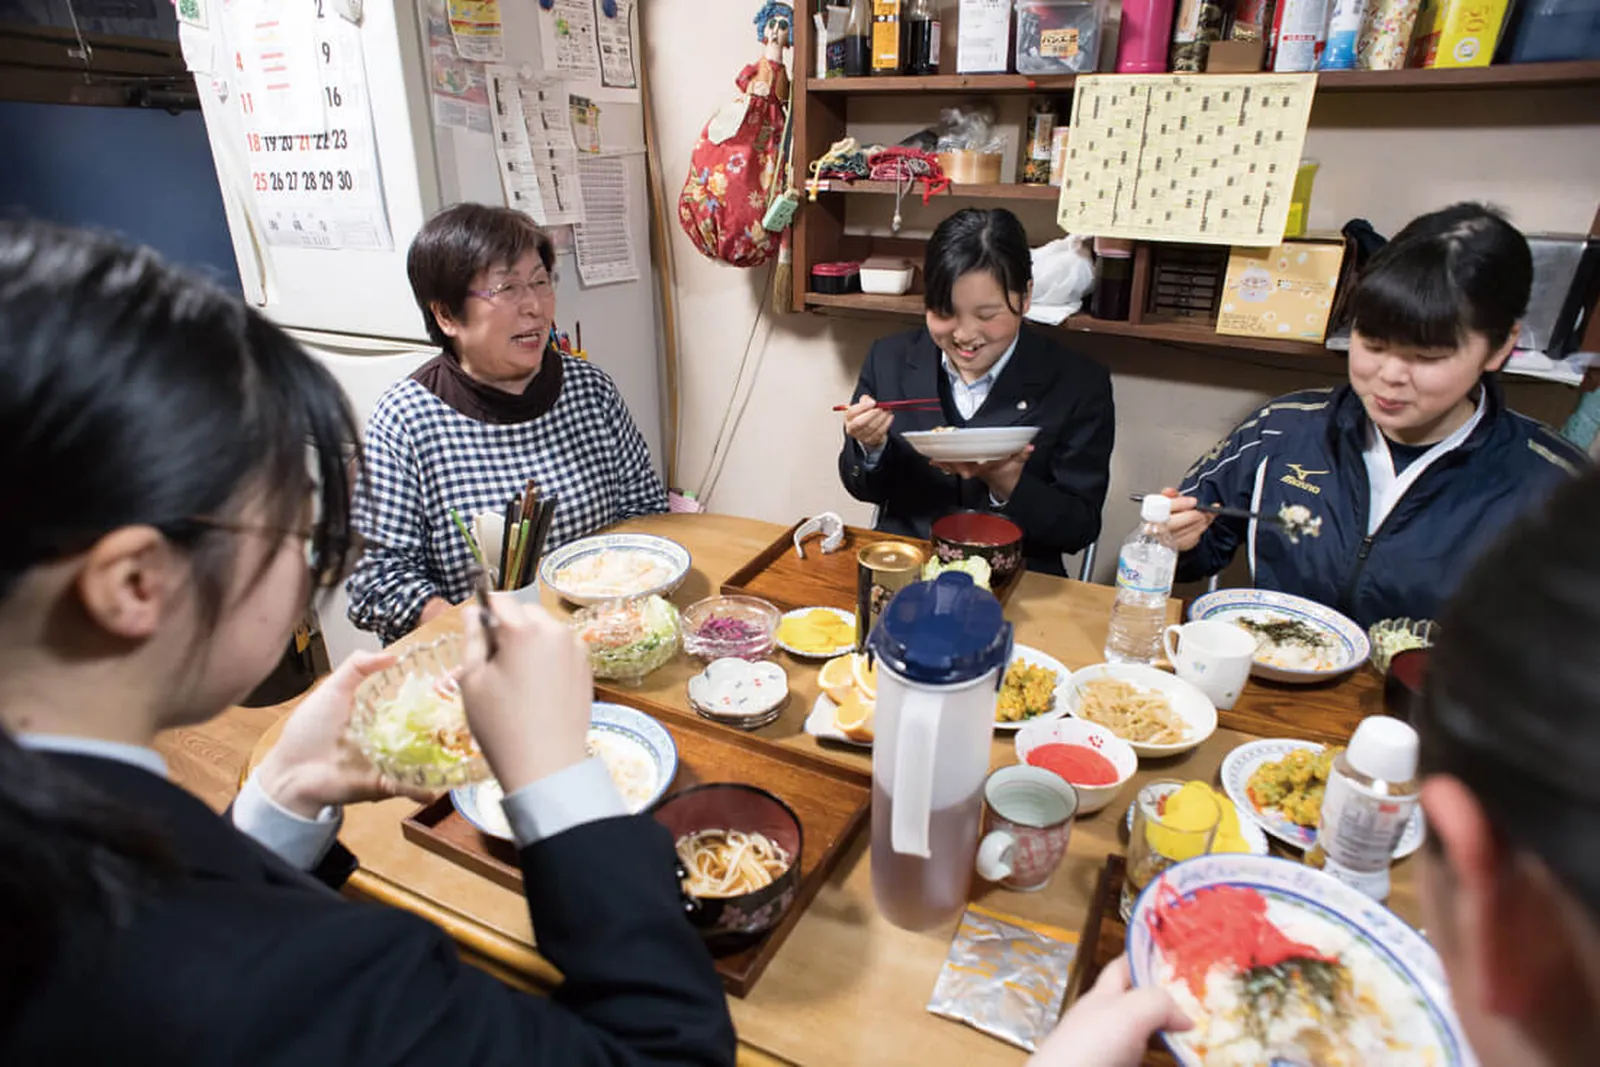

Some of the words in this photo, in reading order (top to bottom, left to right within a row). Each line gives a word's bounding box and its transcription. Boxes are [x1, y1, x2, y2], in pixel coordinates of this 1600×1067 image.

[321, 41, 330, 64] 9
[240, 92, 253, 113] 11
[325, 86, 342, 107] 16
[247, 132, 261, 152] 18
[264, 135, 277, 152] 19
[281, 135, 293, 152] 20
[299, 134, 310, 152] 21
[315, 132, 329, 150] 22
[331, 129, 347, 150] 23
[253, 172, 267, 191] 25
[270, 171, 284, 191] 26
[286, 171, 298, 191] 27
[302, 170, 317, 191] 28
[319, 170, 333, 191] 29
[337, 169, 353, 191] 30
